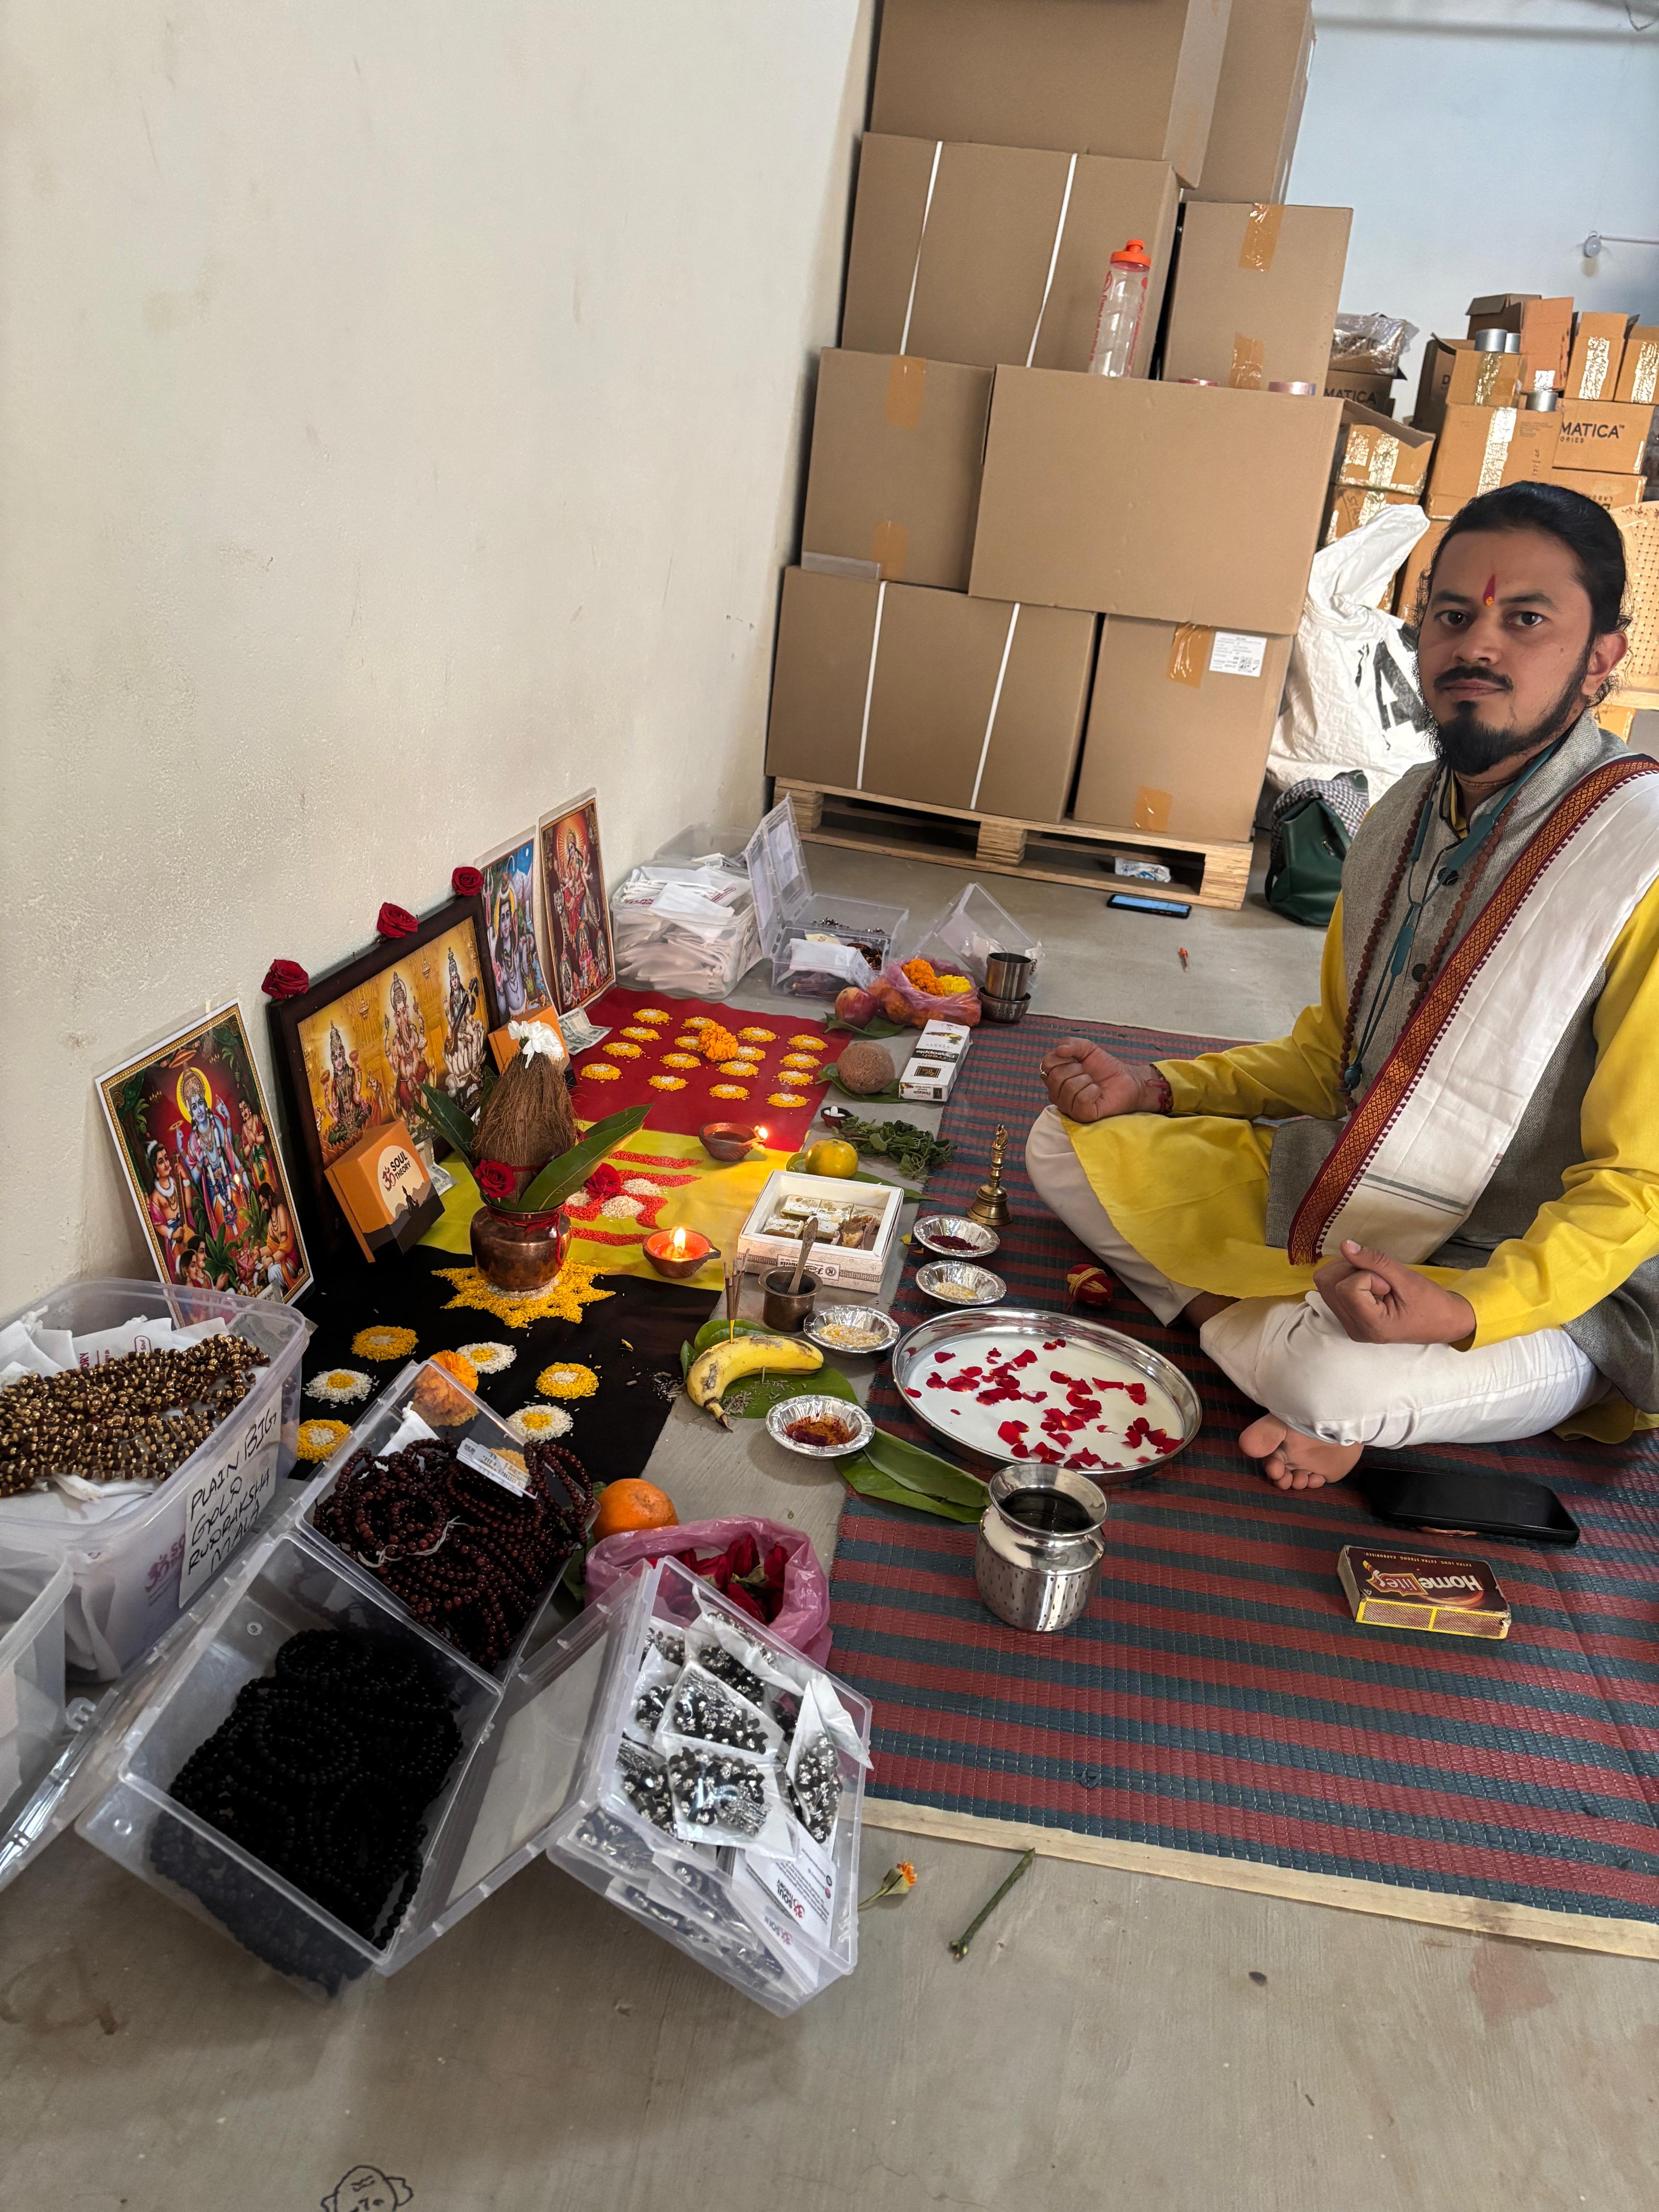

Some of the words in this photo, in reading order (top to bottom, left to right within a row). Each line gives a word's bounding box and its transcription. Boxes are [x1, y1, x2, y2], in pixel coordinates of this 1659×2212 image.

[390, 1151, 408, 1171] SOUL
[395, 1161, 411, 1180] THEORY
[190, 1452, 239, 1521] PLAIN
[188, 1468, 270, 1576] RUDRAKSHA
[191, 1476, 242, 1546] GOLD
[211, 1498, 260, 1573] MALA
[777, 1879, 793, 1899] THEORY
[777, 1887, 792, 1909] SOUL
